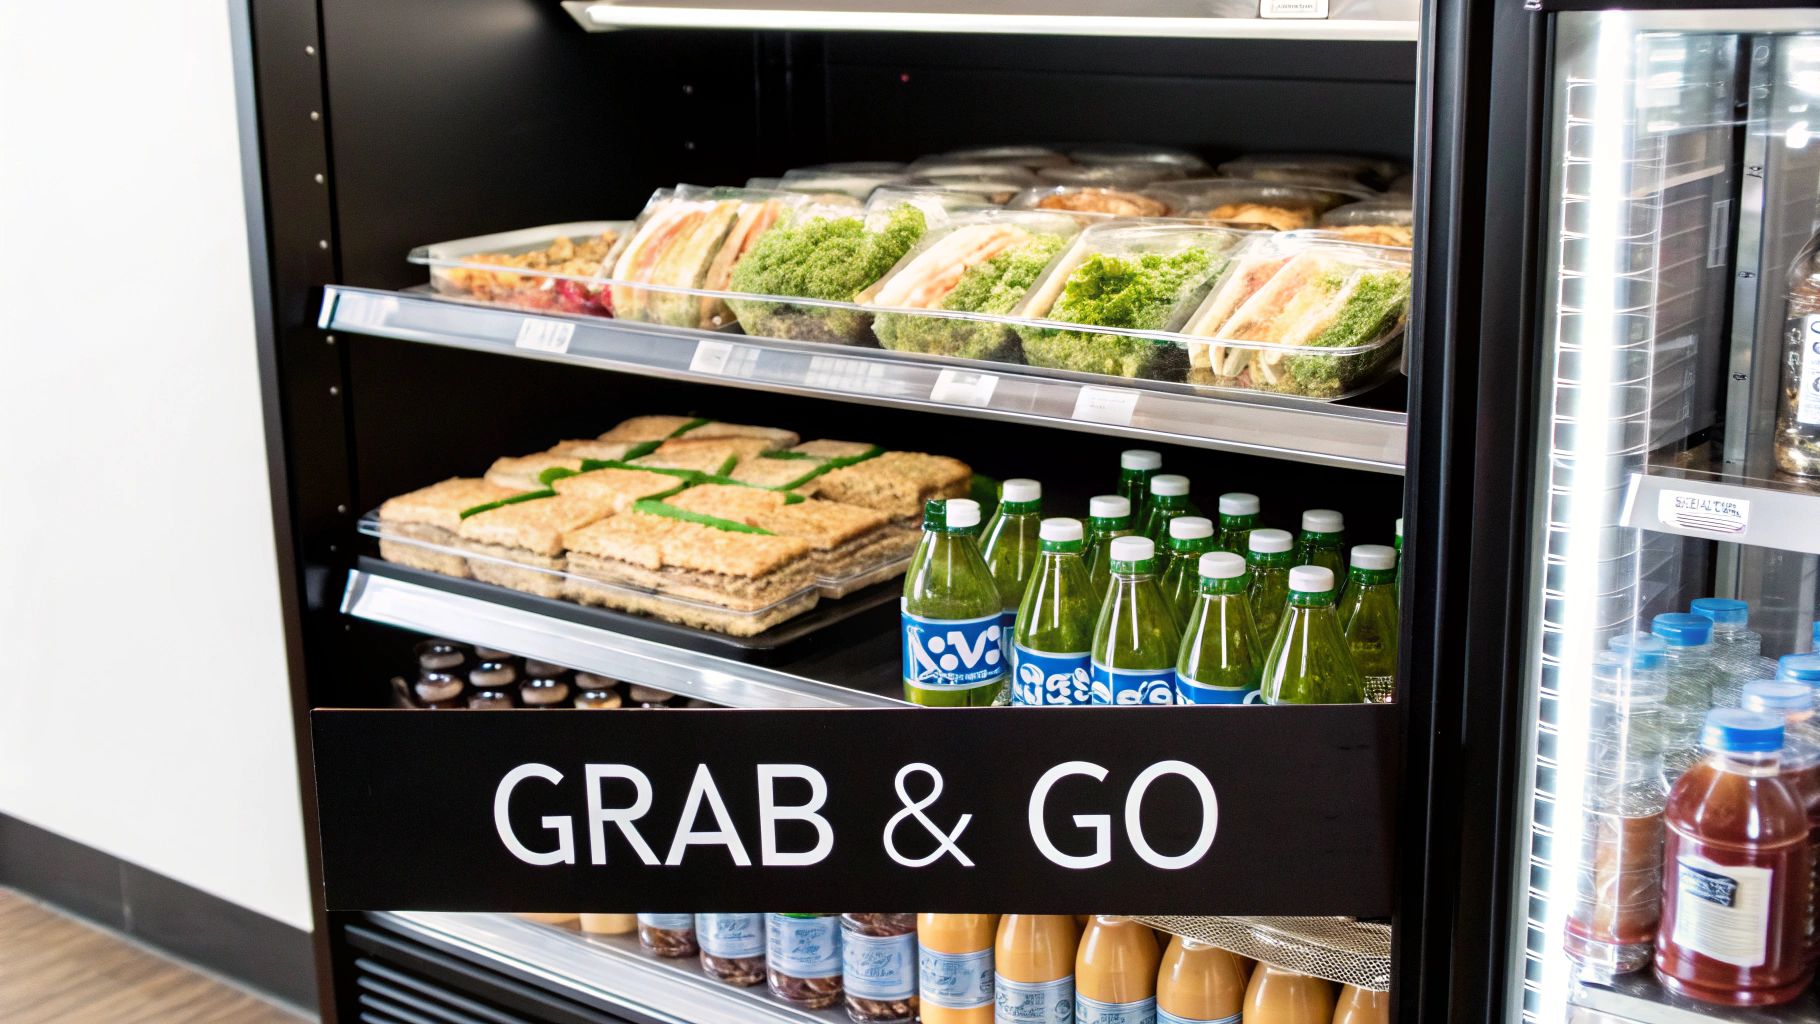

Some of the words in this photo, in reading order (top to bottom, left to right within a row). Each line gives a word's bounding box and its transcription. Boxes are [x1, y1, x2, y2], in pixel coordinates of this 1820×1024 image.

[494, 763, 834, 867] GRAB
[883, 763, 975, 868] &
[1029, 760, 1219, 870] GO
